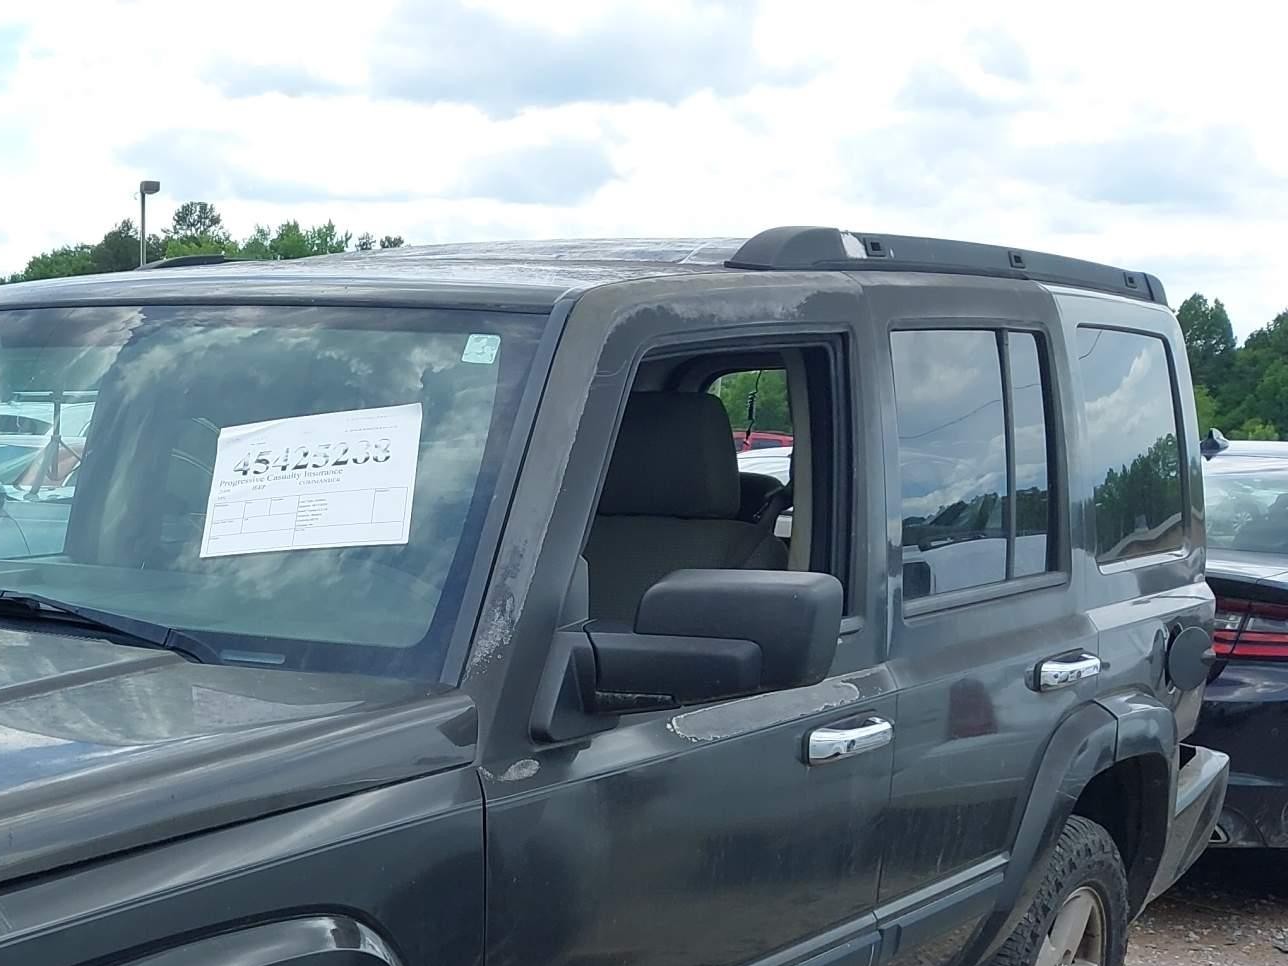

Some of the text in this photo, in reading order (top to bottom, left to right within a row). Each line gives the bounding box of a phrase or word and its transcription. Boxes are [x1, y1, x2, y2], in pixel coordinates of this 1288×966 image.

[219, 467, 344, 488] Progressive Casualty Insurance
